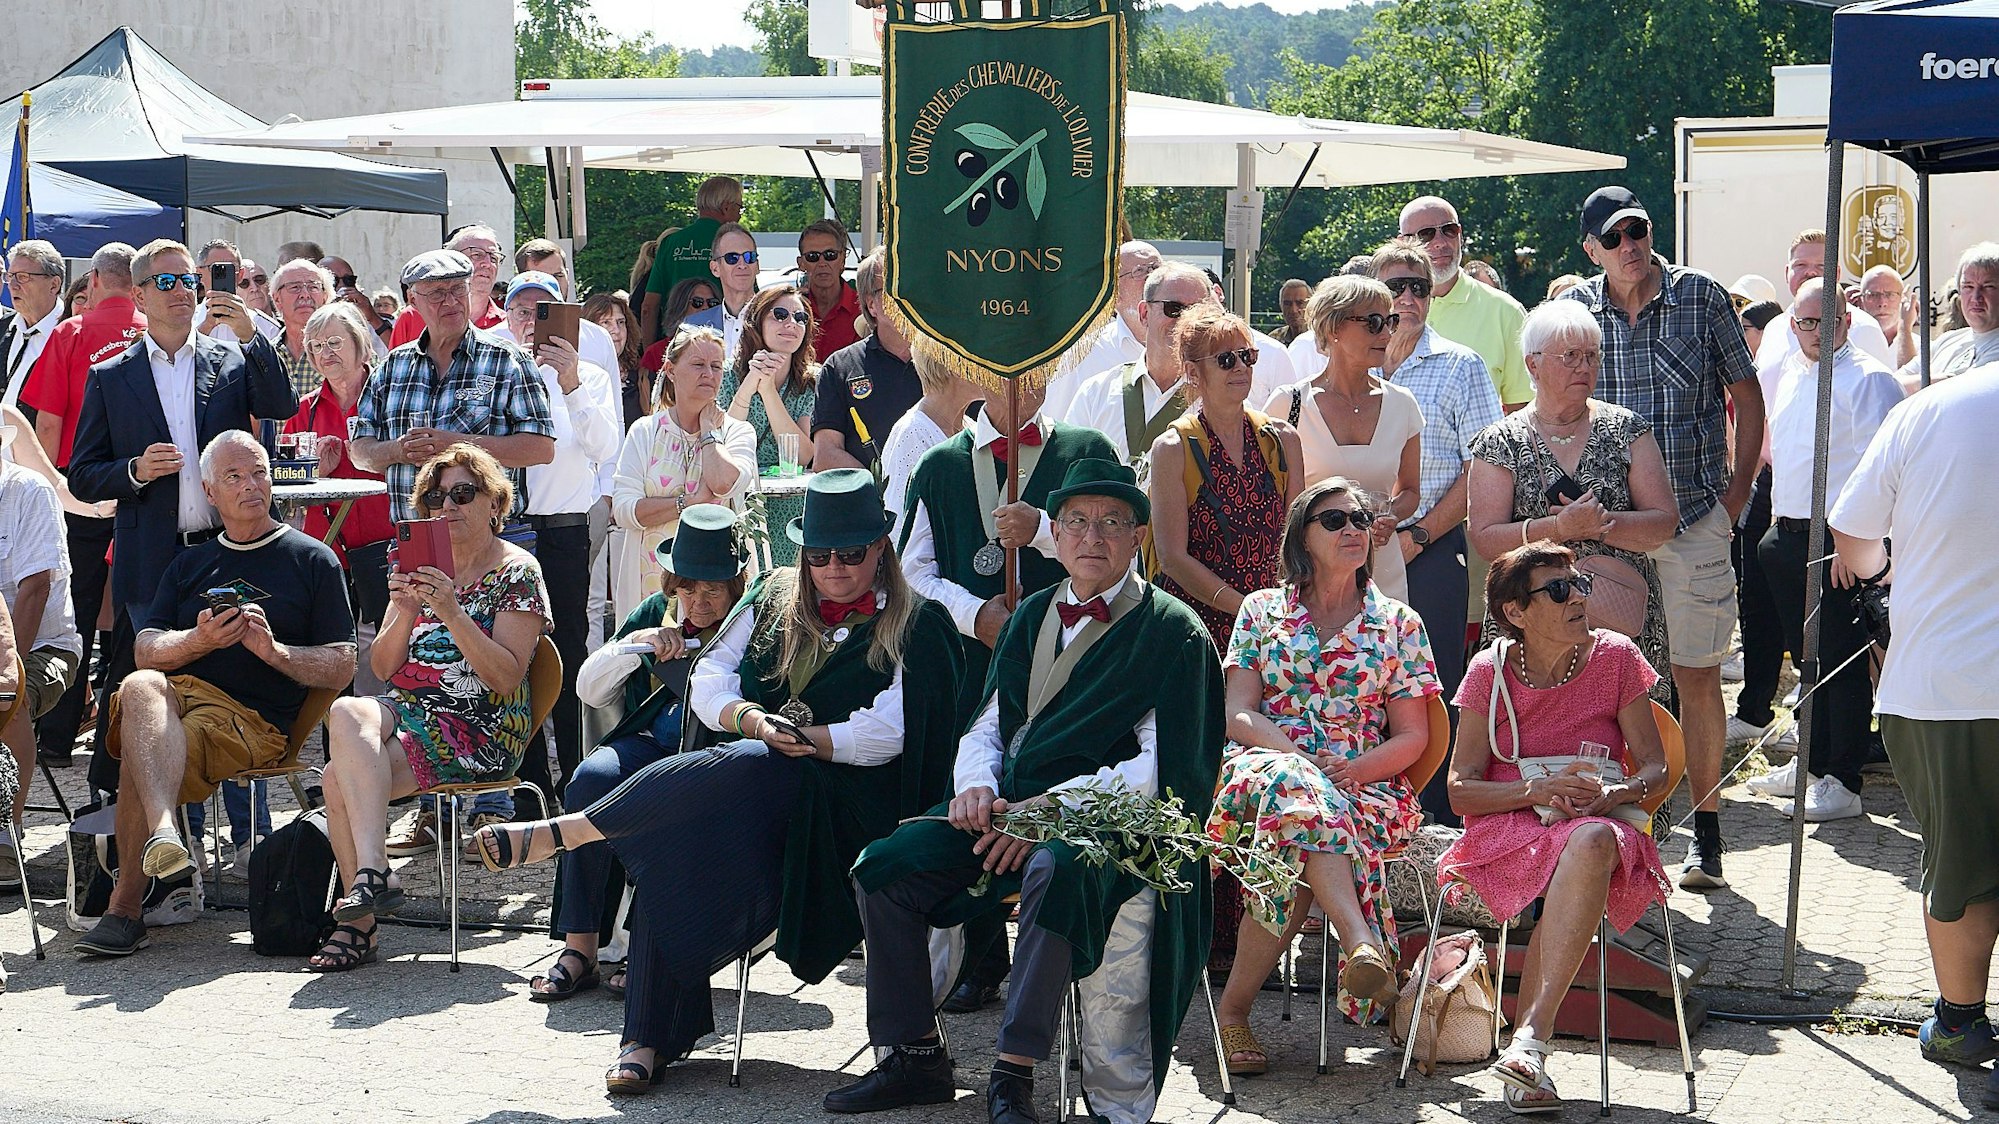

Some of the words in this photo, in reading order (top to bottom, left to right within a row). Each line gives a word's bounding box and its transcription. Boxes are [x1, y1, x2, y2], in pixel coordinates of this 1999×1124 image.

[949, 79, 970, 103] DES
[968, 61, 1062, 100] CHEVALIERS
[1052, 93, 1070, 113] DE
[1062, 104, 1093, 179] L'OLIVIER
[946, 247, 1063, 273] NYONS
[980, 299, 1031, 316] 1964
[122, 329, 137, 339] KG
[274, 466, 307, 480] Kölsch
